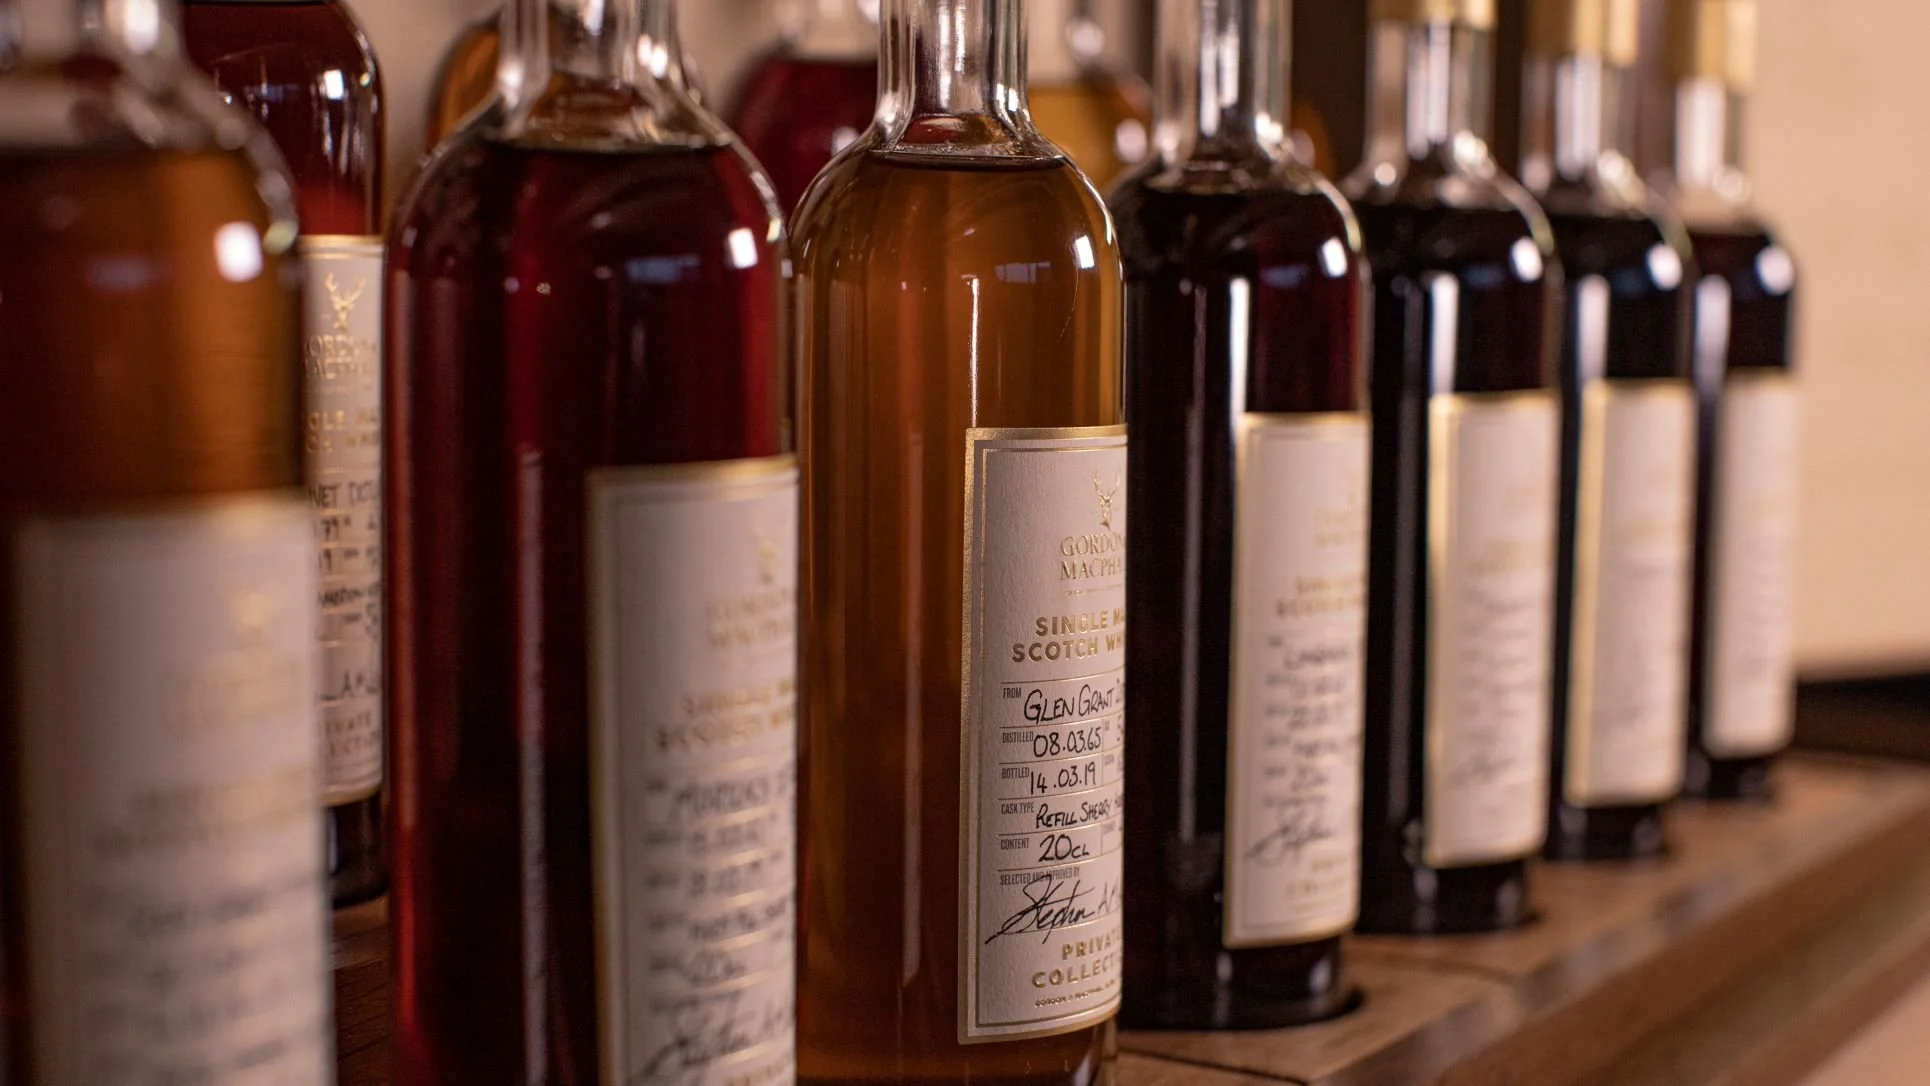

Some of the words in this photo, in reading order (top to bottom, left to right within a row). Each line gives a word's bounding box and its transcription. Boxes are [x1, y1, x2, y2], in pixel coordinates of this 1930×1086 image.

[1035, 610, 1108, 637] SINGLE
[1011, 636, 1099, 664] SCOTCH
[1003, 687, 1022, 699] FROM
[1024, 688, 1075, 724] GLEN
[1078, 684, 1115, 717] GRANT
[1002, 731, 1034, 744] DISTILLED
[1033, 727, 1101, 758] 08.03.65
[1001, 767, 1030, 780] BOTTLED
[1001, 803, 1019, 815] CASK
[1019, 802, 1034, 813] TYPE
[1001, 838, 1030, 850] CONTENT
[1000, 872, 1031, 885] SELECTED
